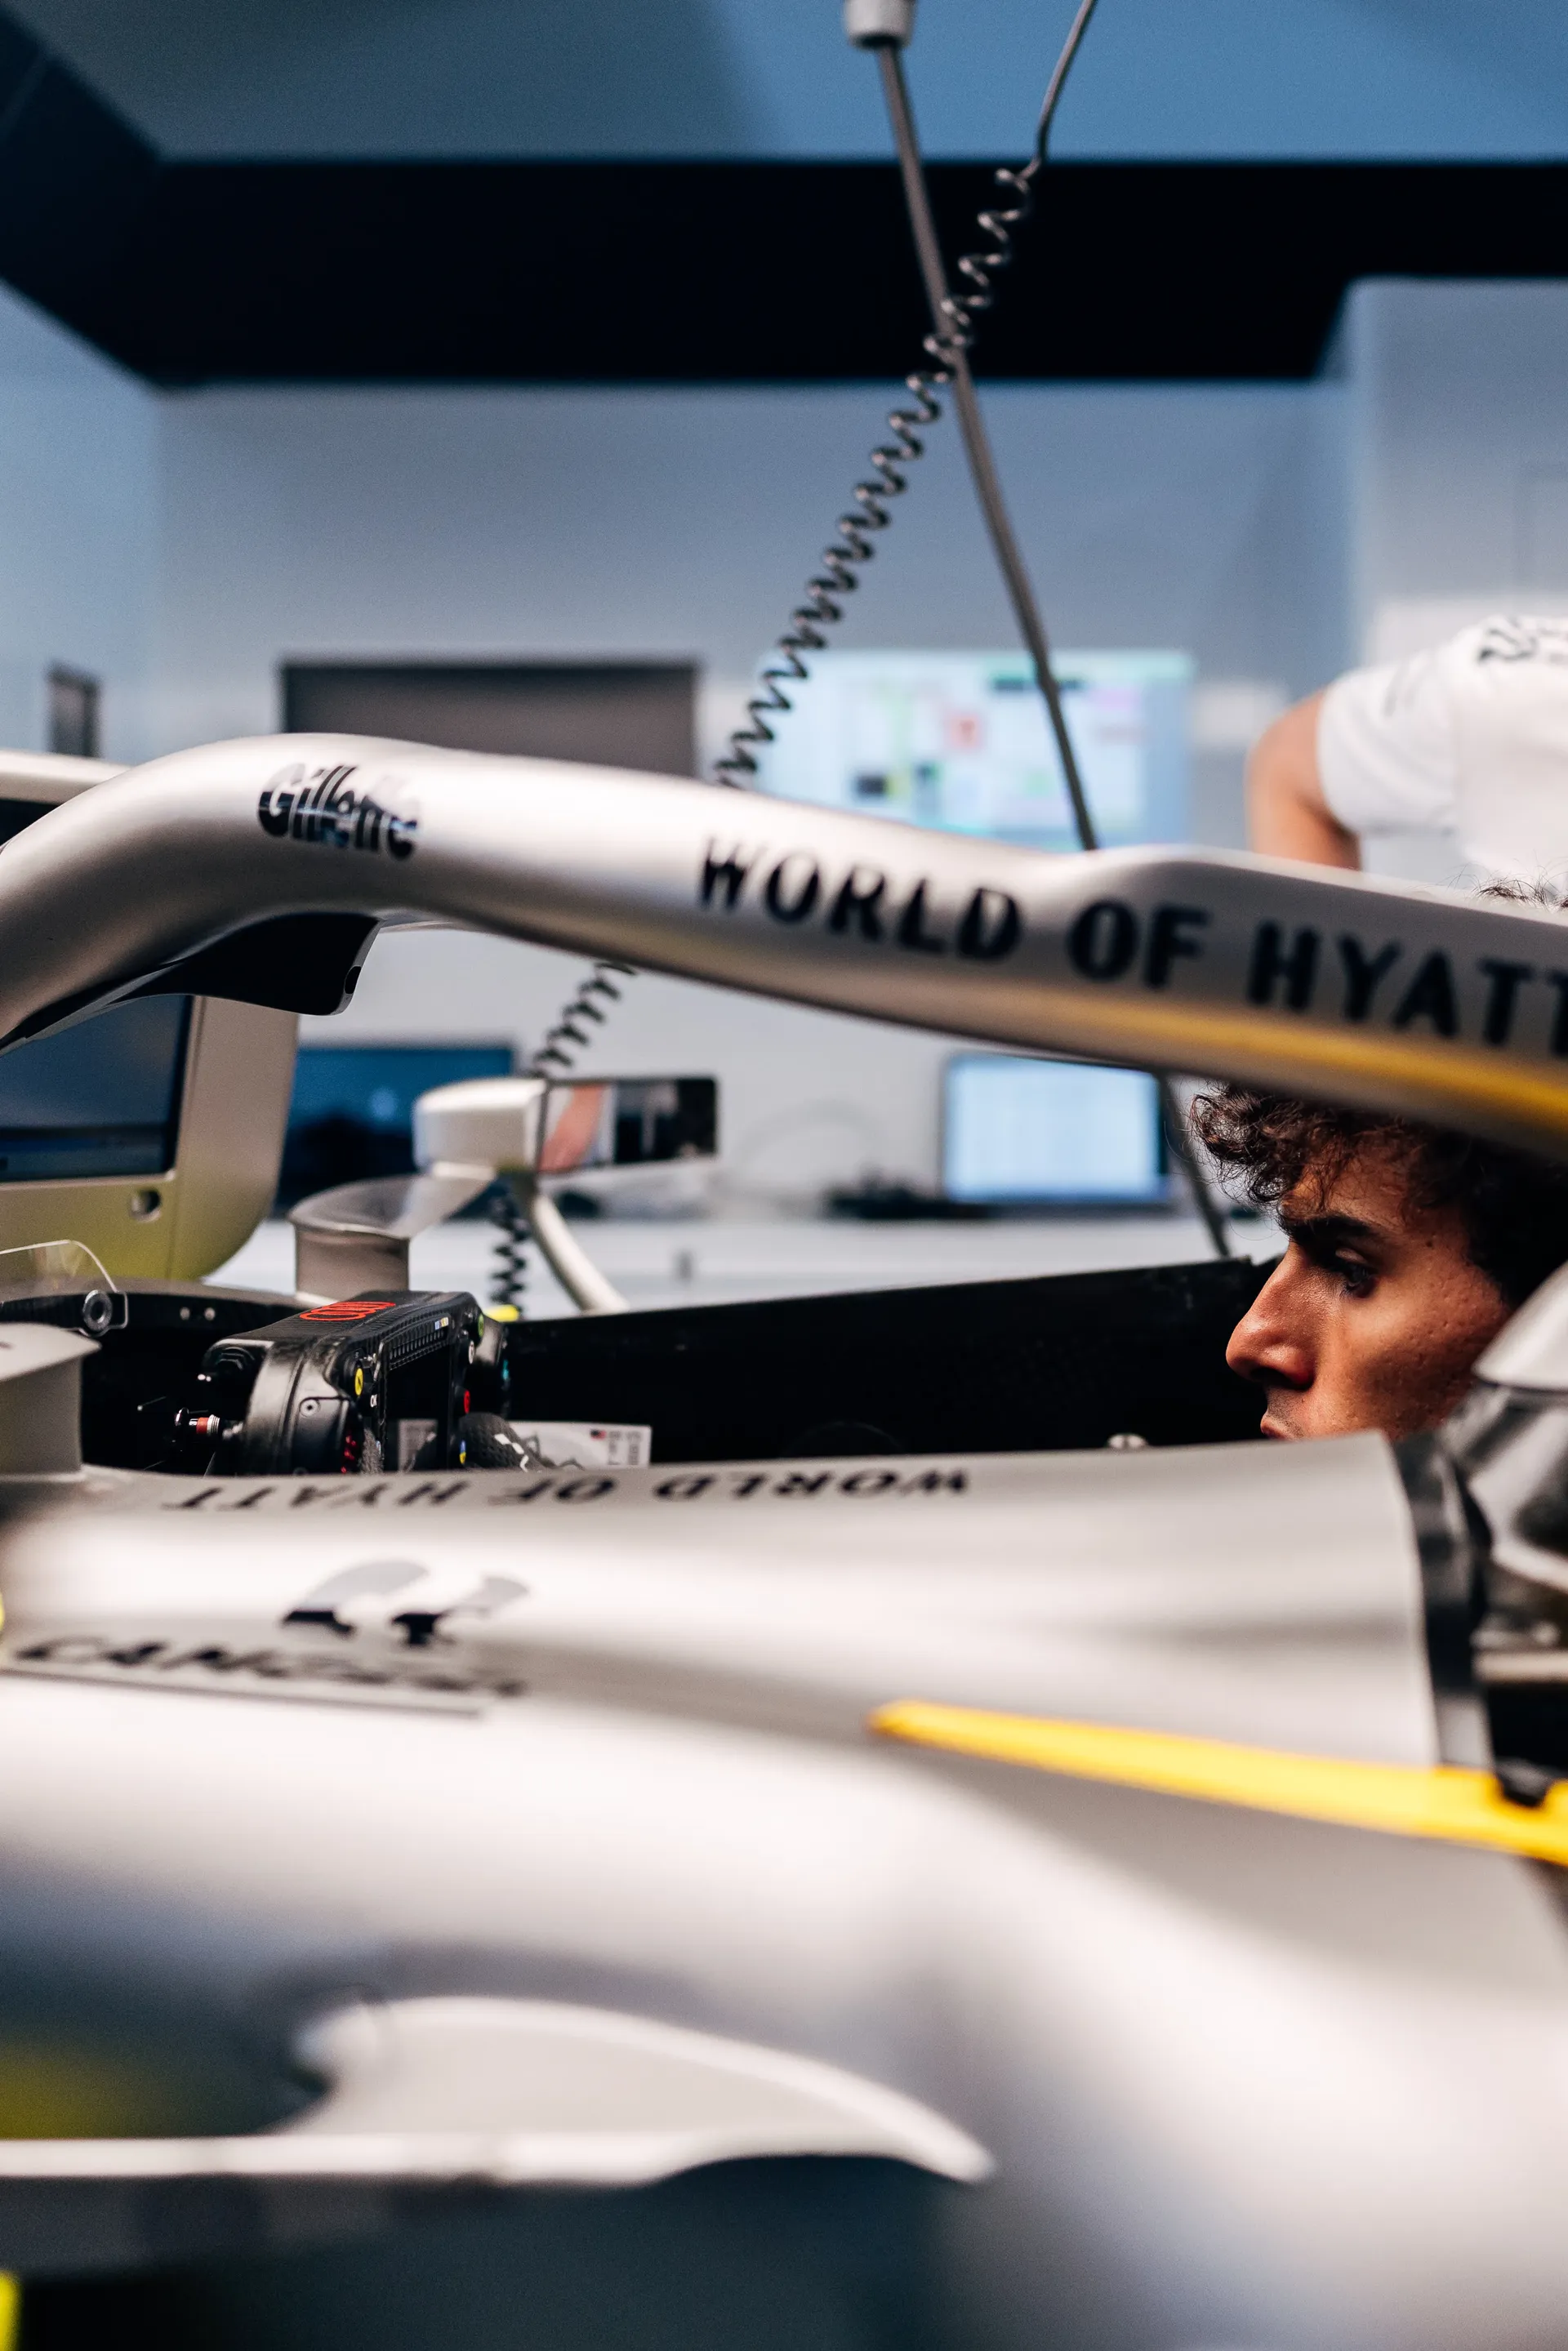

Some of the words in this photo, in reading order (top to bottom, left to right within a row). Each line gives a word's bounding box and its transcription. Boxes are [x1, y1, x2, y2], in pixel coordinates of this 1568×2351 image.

[698, 835, 1022, 964] WORLD
[1067, 898, 1210, 990] OF
[163, 1480, 471, 1511] HYATT
[490, 1476, 618, 1507] OF
[655, 1469, 969, 1501] WORLD
